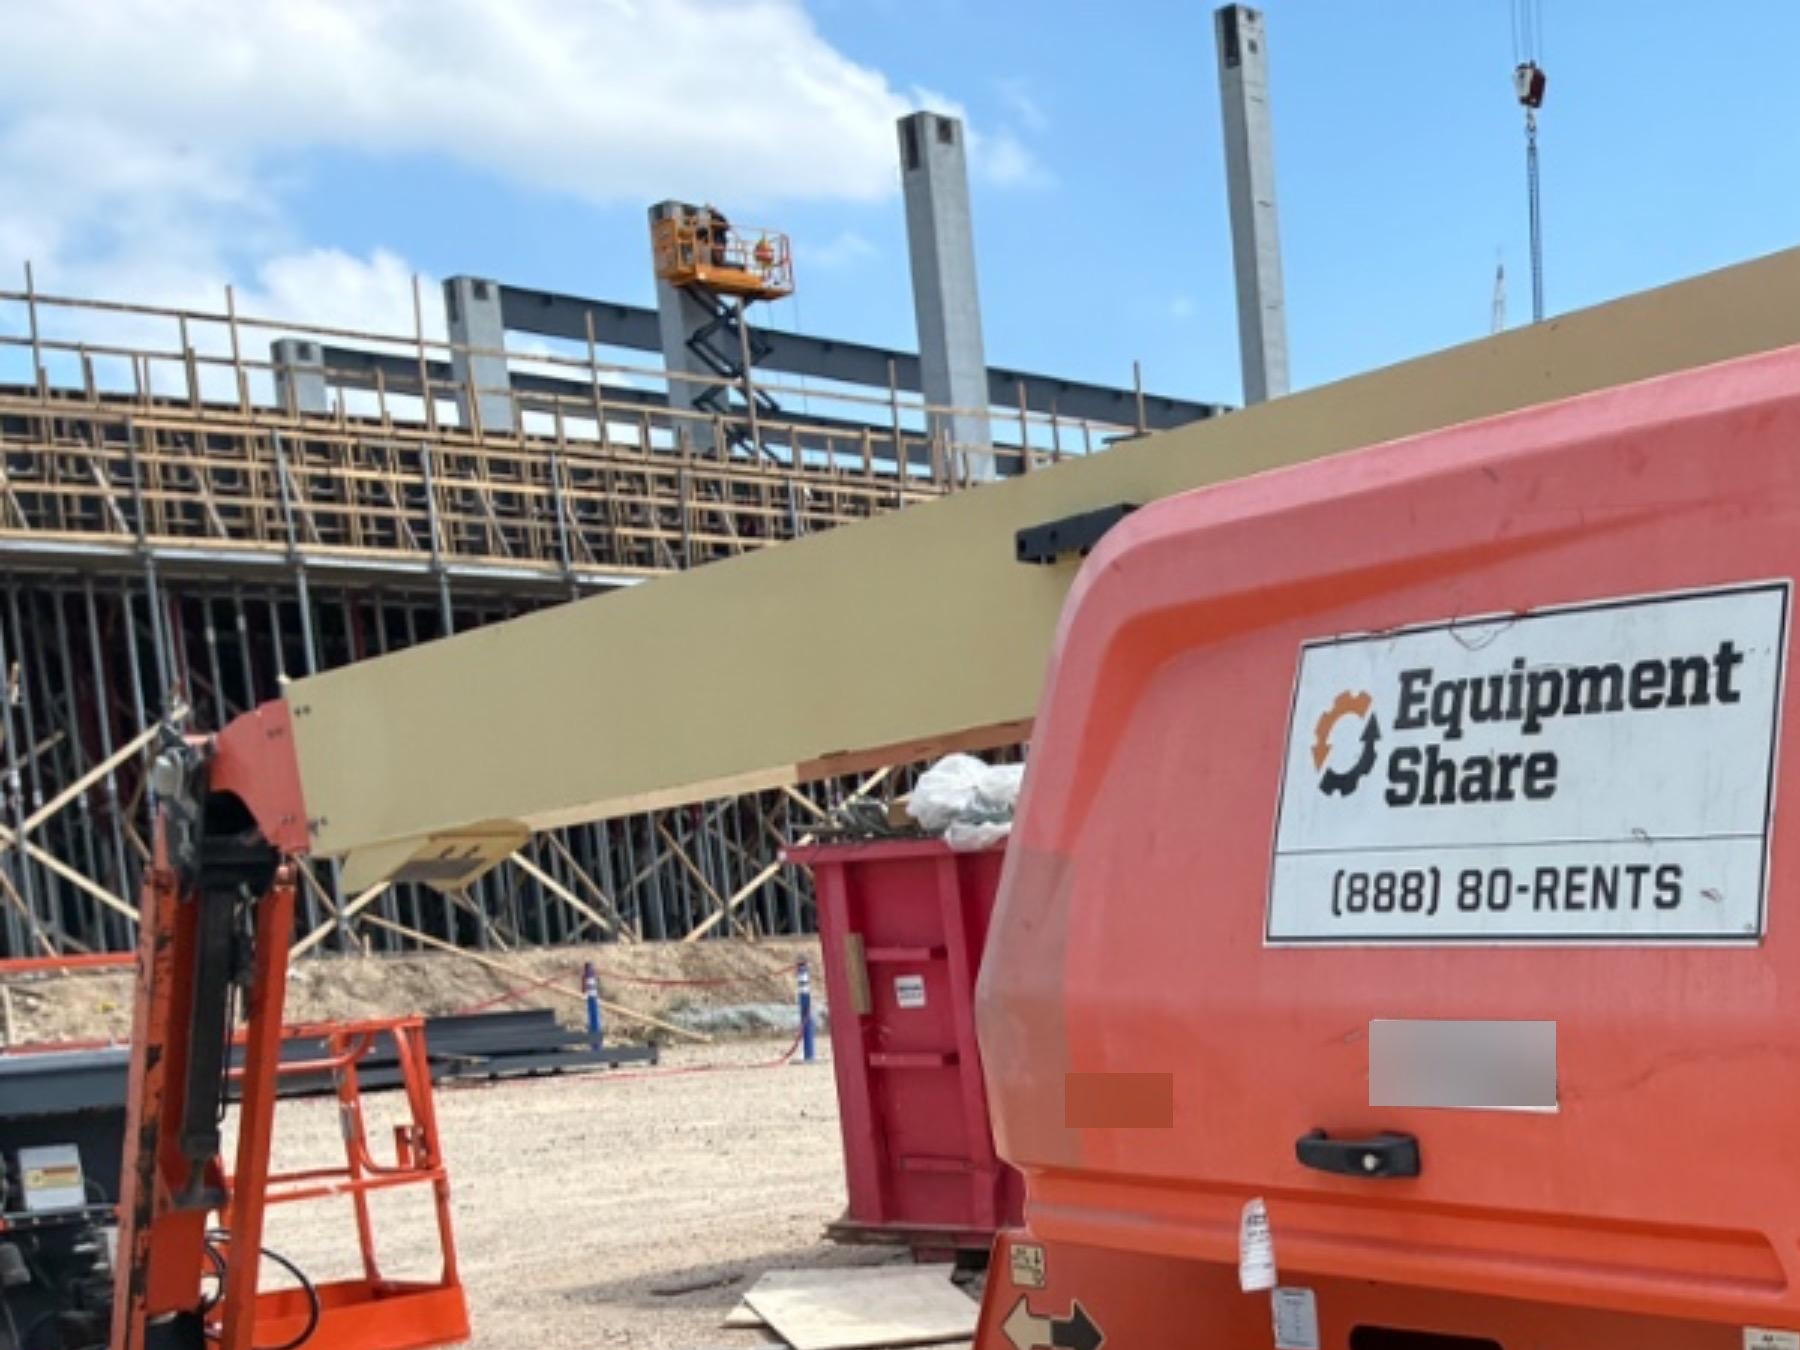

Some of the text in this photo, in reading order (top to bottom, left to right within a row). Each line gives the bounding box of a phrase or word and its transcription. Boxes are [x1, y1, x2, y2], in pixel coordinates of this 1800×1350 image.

[1392, 640, 1744, 740] Equipment
[1384, 745, 1559, 808] Share
[1331, 864, 1684, 916] (888) 80-RENTS
